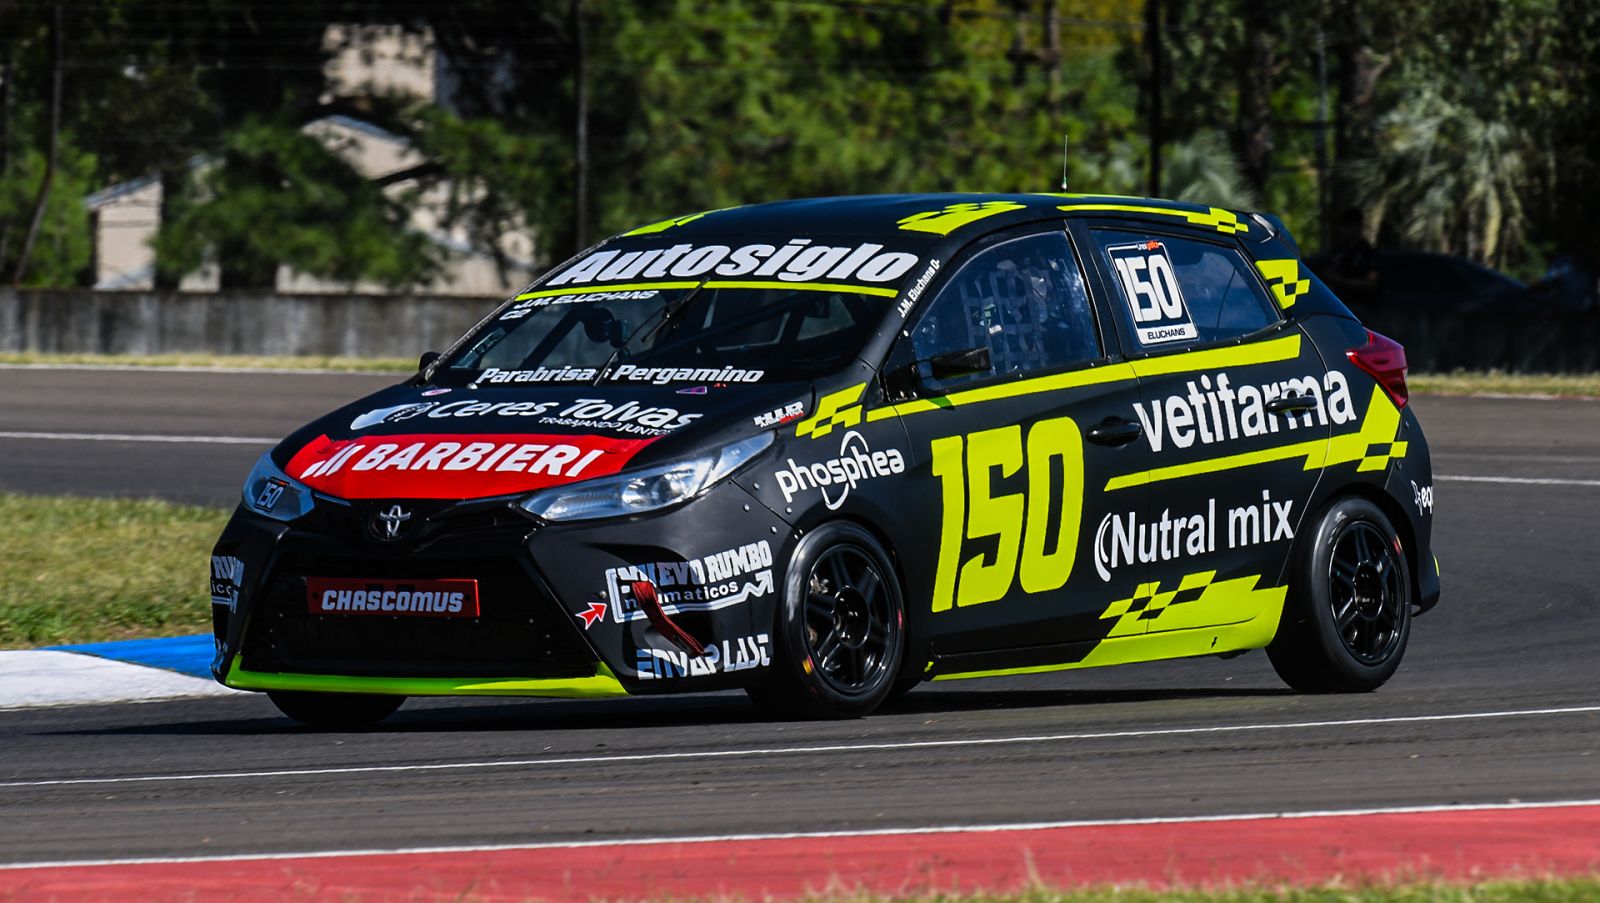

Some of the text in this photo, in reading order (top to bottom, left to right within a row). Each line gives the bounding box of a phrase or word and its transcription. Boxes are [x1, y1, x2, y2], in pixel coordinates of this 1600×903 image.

[546, 239, 919, 286] Autosiglo
[551, 290, 660, 305] ELUCHANS
[907, 266, 936, 302] Eluchans
[1114, 254, 1183, 322] 150
[1147, 327, 1186, 340] ELUCHANS
[610, 364, 765, 385] Pergamino
[428, 400, 560, 418] Ceres
[558, 399, 704, 429] Tolvas
[538, 416, 622, 428] TRABAJANDO
[1133, 369, 1357, 453] vetifarma
[351, 442, 605, 478] BARBIERI
[775, 446, 905, 503] phosphea
[256, 482, 284, 508] 150
[931, 416, 1085, 613] 150
[1111, 489, 1295, 569] Nutral mix
[704, 540, 773, 583] RUMBO
[321, 590, 464, 613] CHASCOMUS
[624, 581, 739, 610] nmaticos
